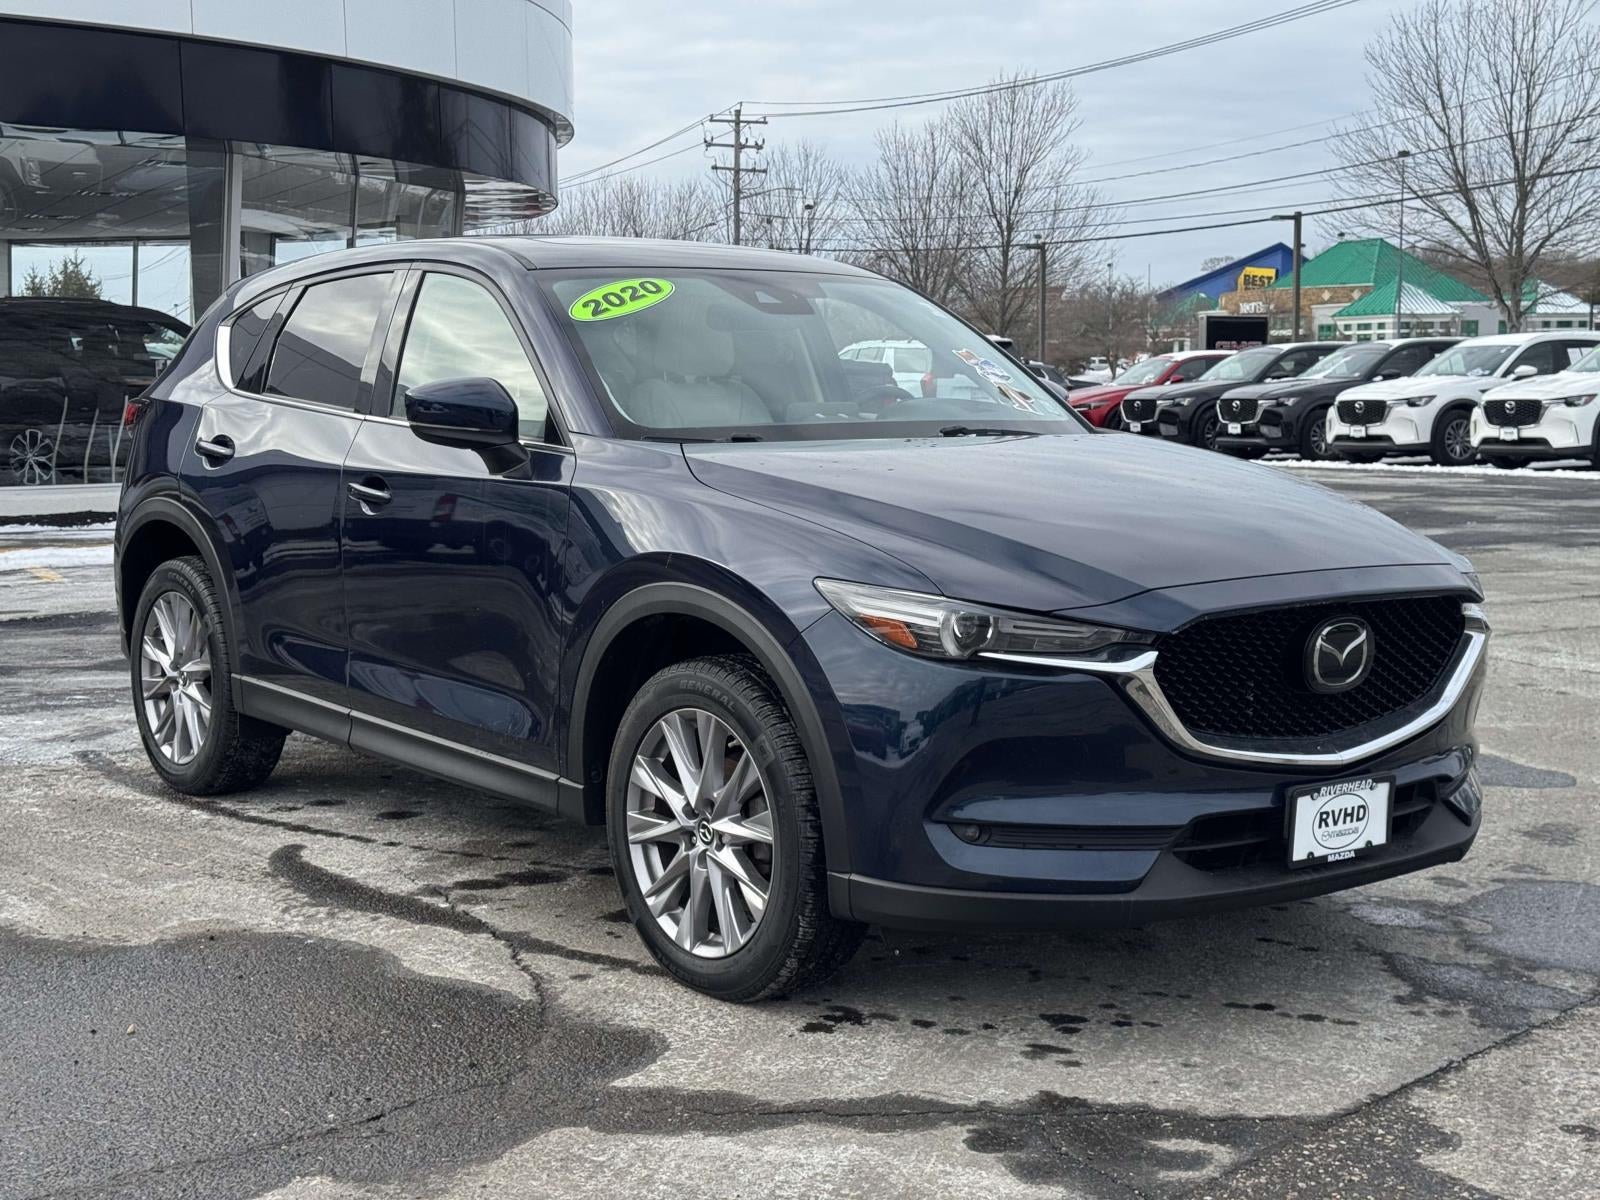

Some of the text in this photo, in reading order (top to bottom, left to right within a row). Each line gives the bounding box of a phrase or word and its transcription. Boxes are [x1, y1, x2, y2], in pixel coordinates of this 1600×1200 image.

[1243, 274, 1274, 287] BEST
[582, 280, 662, 317] 2020
[679, 679, 735, 712] GENERAL
[1319, 778, 1373, 798] RIVERHEAD
[1318, 804, 1367, 829] RVHD
[1327, 849, 1356, 863] MAZDA
